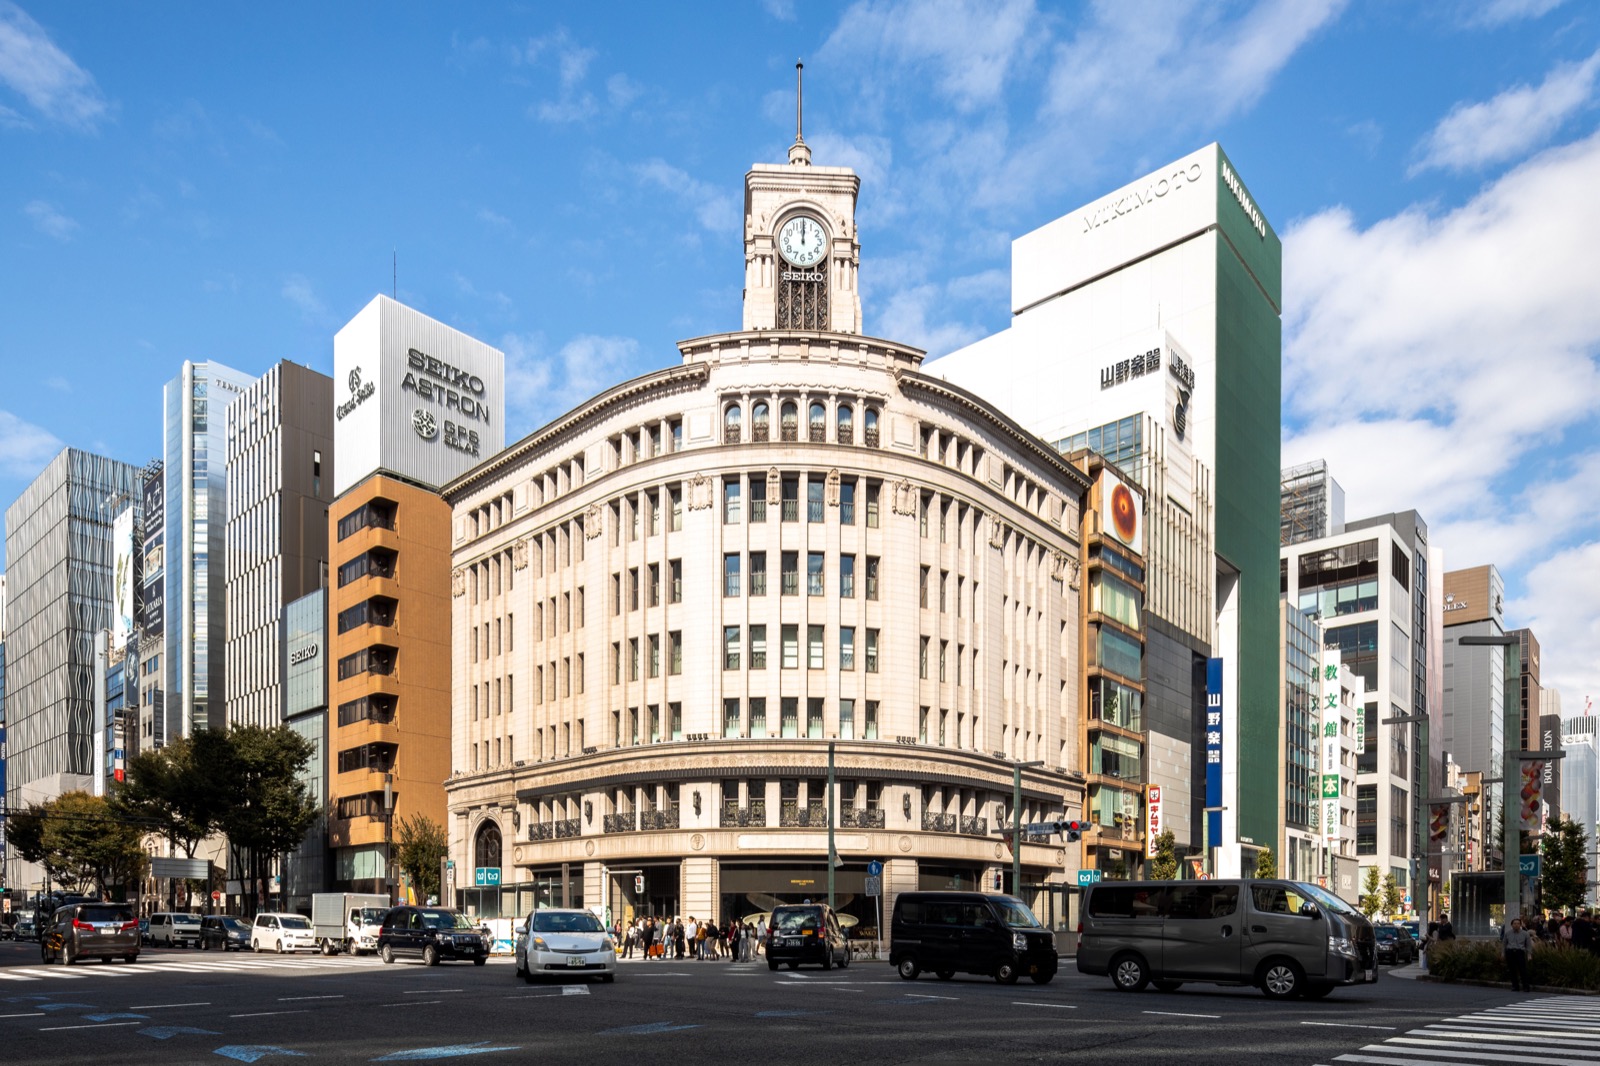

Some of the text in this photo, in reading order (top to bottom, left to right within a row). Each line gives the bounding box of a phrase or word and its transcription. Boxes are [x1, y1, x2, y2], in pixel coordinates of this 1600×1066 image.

[1083, 163, 1202, 234] MIKIMOTO
[1221, 160, 1266, 238] MIKIMOTO
[784, 237, 789, 245] 9
[786, 229, 793, 237] 10
[814, 229, 820, 238] 2
[817, 239, 822, 247] 3
[786, 245, 792, 253] 8
[793, 251, 799, 259] 7
[800, 254, 806, 262] 6
[808, 252, 813, 260] 5
[813, 246, 819, 254] 4
[783, 272, 823, 282] SEIKO
[407, 348, 485, 395] SEIKO
[1101, 347, 1160, 389] 山野楽器
[336, 381, 376, 421] Grand Seiko
[401, 372, 489, 422] ASTRON
[444, 419, 480, 445] GPS
[444, 433, 480, 458] SOLAR
[1442, 601, 1468, 612] OLEX
[290, 642, 318, 666] SEIKO
[1324, 664, 1338, 738] 教文館
[1207, 693, 1221, 764] 山野楽器
[1543, 730, 1553, 784] BOUCERON
[1324, 778, 1338, 795] 本
